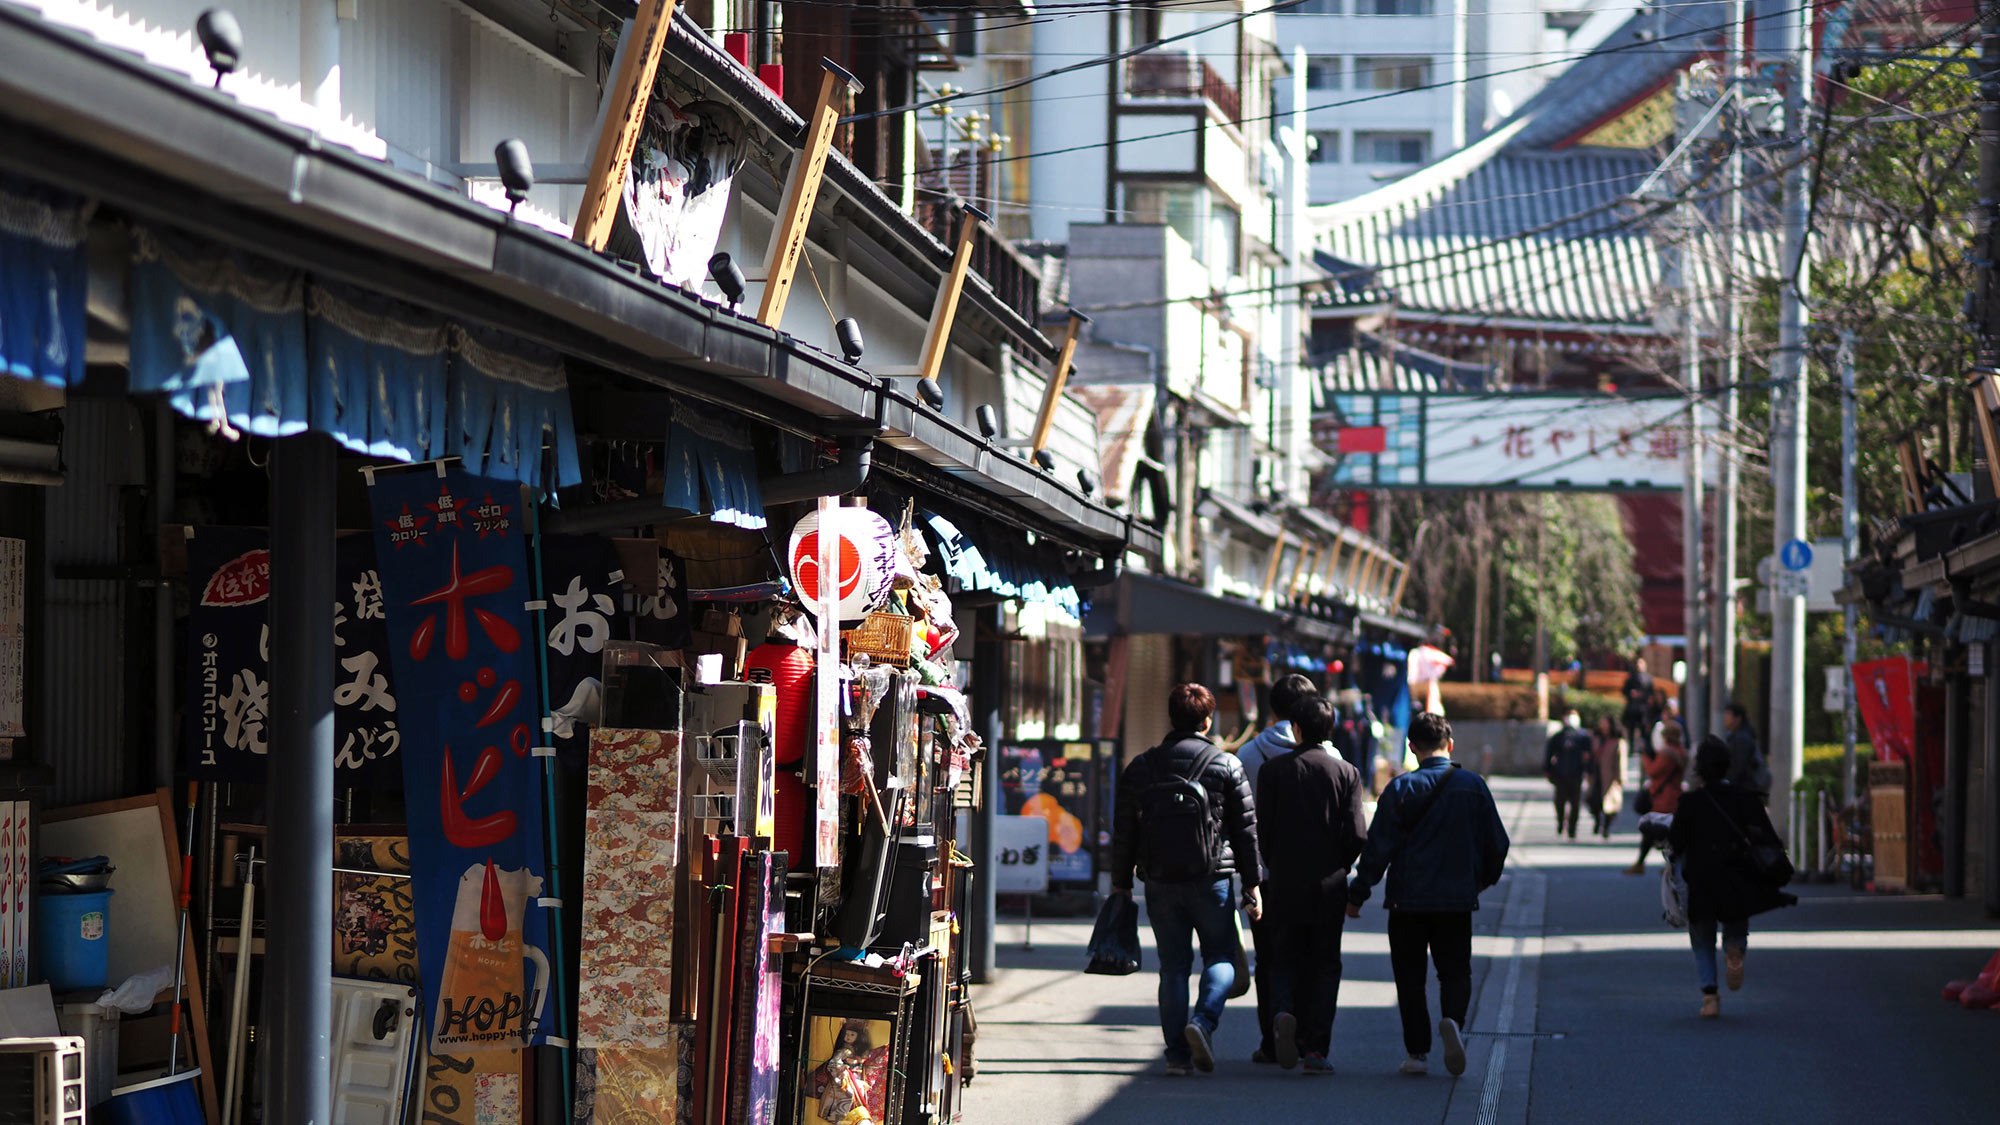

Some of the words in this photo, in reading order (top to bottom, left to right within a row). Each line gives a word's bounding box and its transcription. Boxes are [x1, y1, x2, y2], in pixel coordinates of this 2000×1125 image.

[478, 505, 501, 518] ゼロ
[391, 530, 428, 542] カロリー
